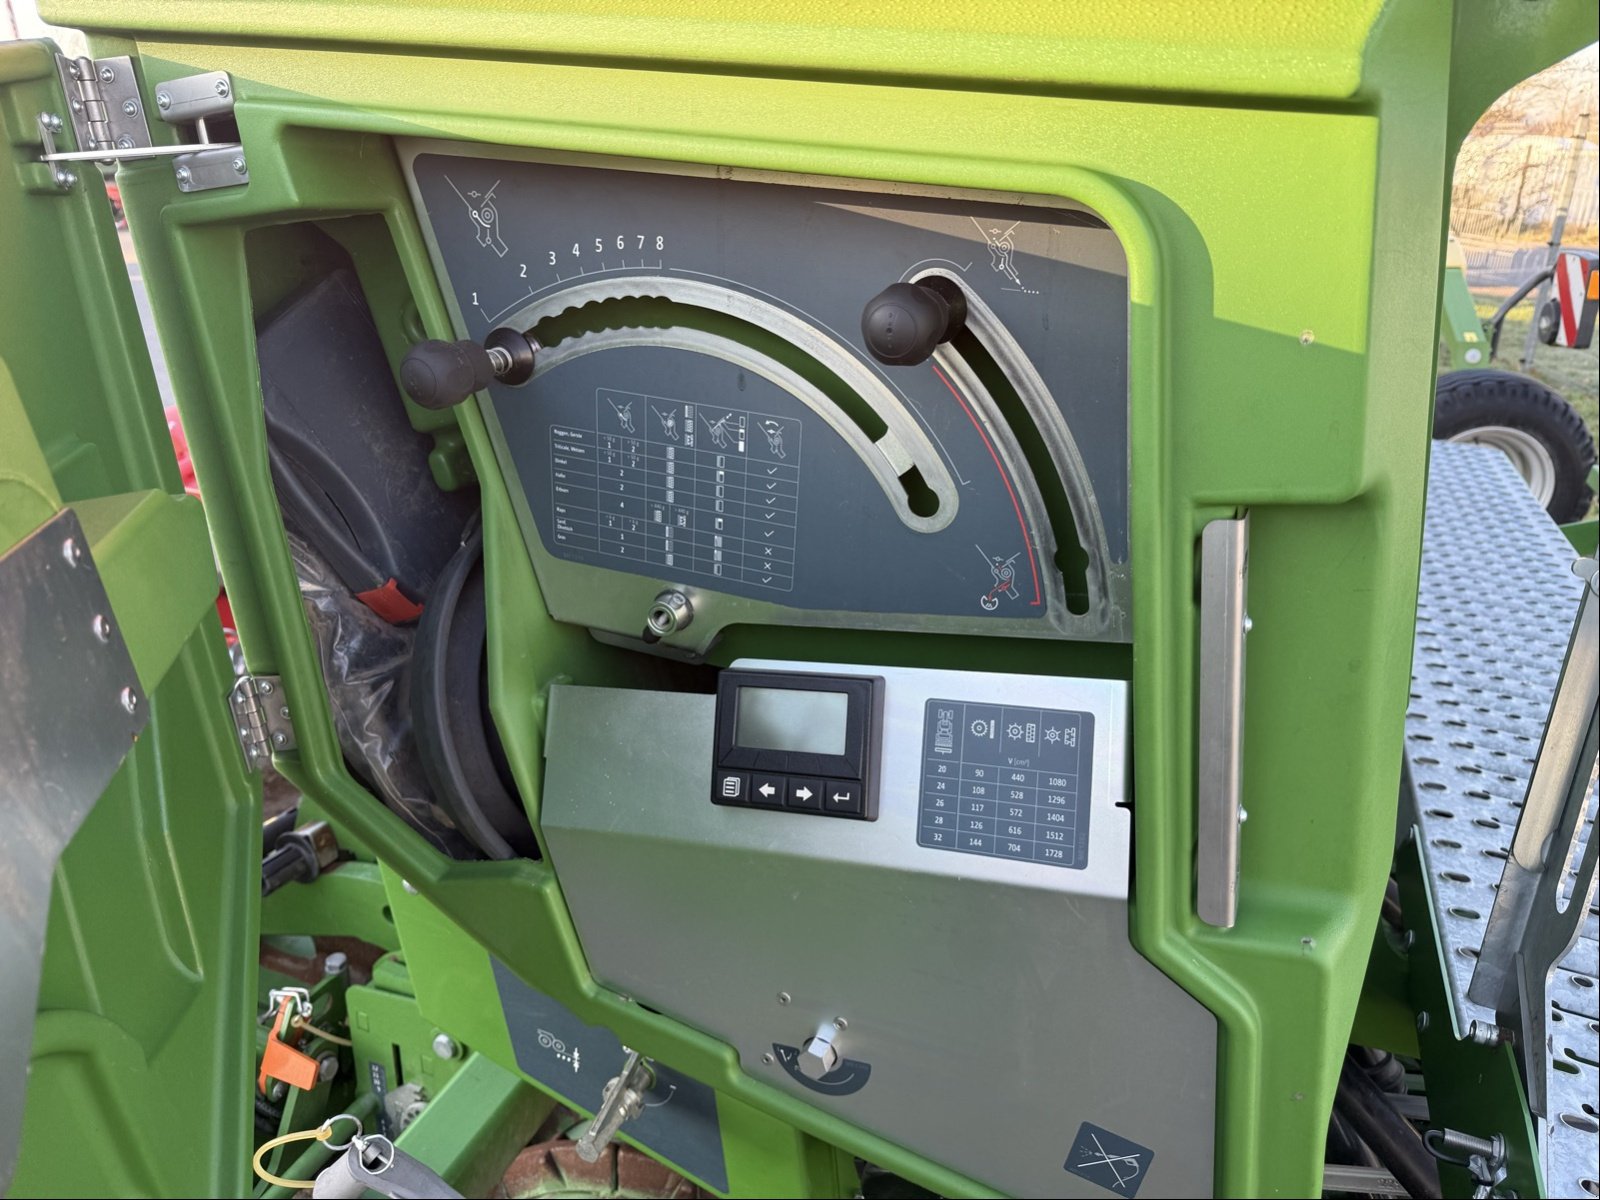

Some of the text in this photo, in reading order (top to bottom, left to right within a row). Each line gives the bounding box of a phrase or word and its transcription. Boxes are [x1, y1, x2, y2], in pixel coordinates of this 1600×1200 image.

[596, 239, 602, 252] 5
[617, 236, 624, 249] 6
[637, 235, 644, 249] 7
[656, 236, 663, 250] 8
[573, 244, 579, 256] 4
[549, 252, 556, 265] 3
[520, 264, 526, 277] 2
[473, 293, 478, 305] 1
[938, 765, 946, 773] 20
[975, 769, 984, 777] 90
[1049, 778, 1066, 786] 1080
[973, 786, 984, 794] 108
[1011, 791, 1023, 799] 528
[1048, 796, 1065, 804] 1296
[1010, 808, 1022, 816] 572
[935, 816, 943, 824] 28
[1048, 813, 1064, 822] 1404
[971, 821, 983, 829] 126
[1009, 826, 1021, 835] 616
[934, 833, 942, 841] 32
[1046, 831, 1063, 840] 1512
[970, 838, 982, 846] 144
[1008, 843, 1020, 851] 704
[1046, 849, 1062, 858] 1728
